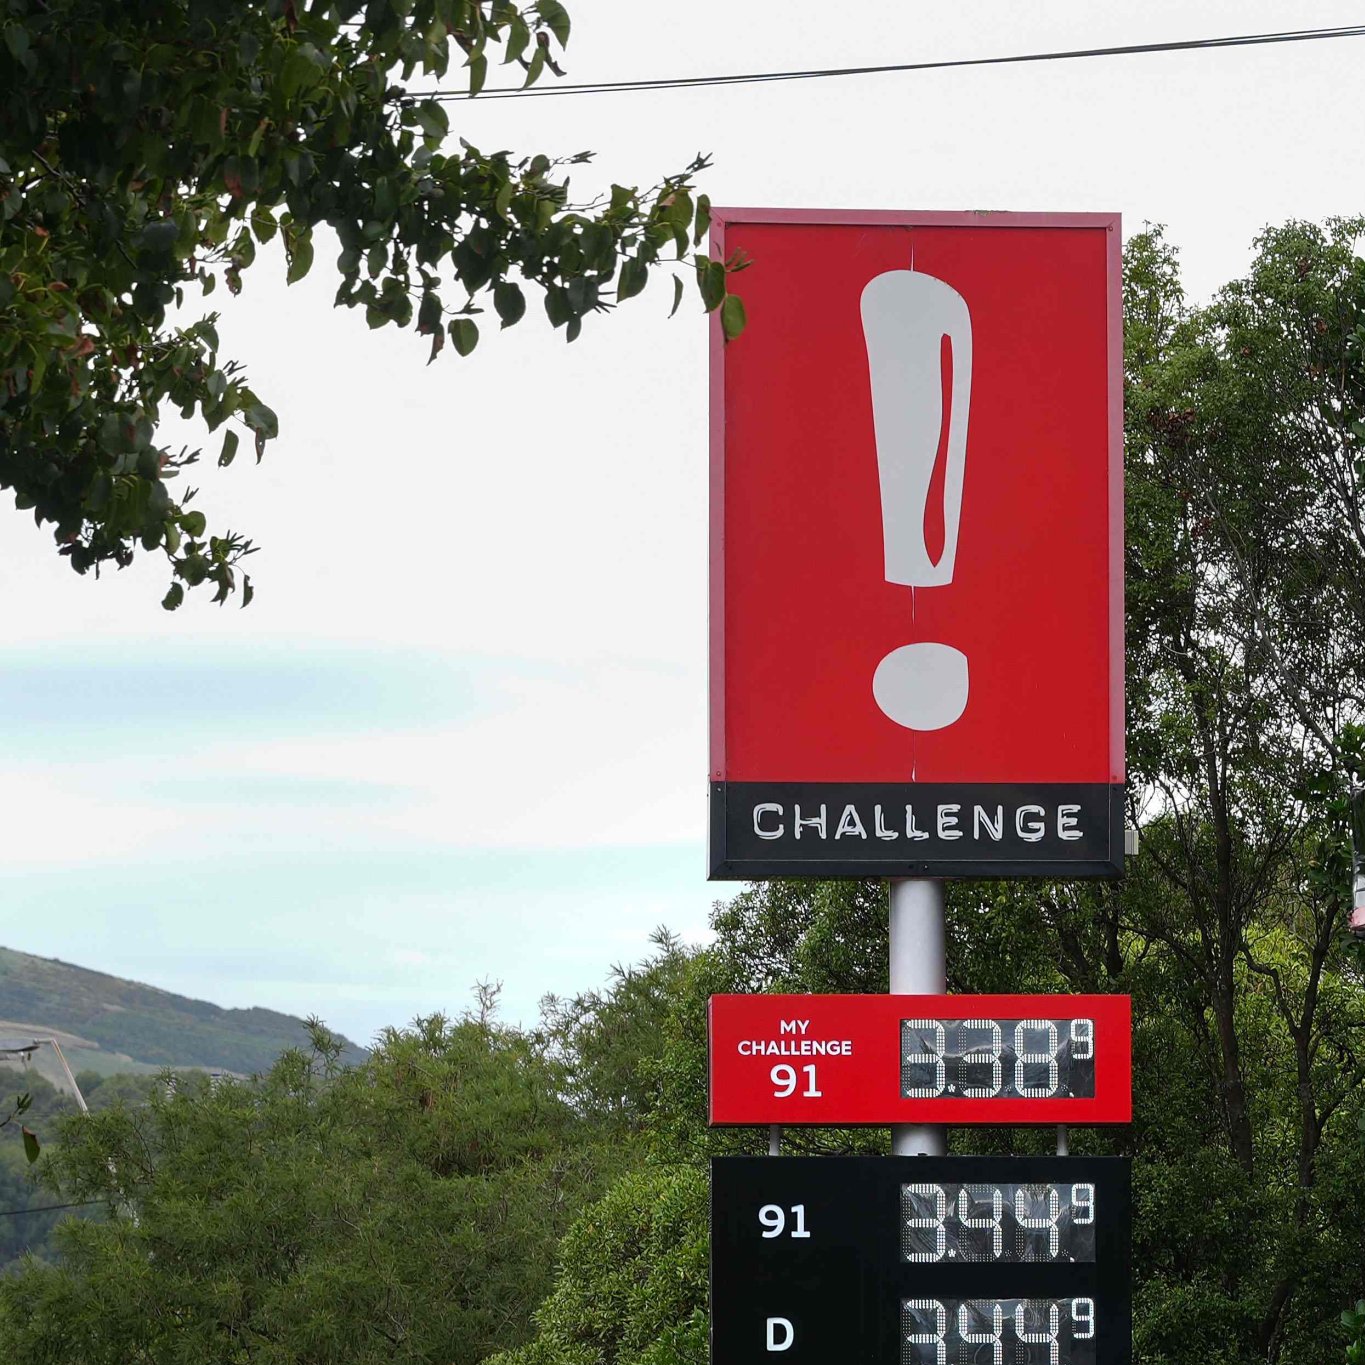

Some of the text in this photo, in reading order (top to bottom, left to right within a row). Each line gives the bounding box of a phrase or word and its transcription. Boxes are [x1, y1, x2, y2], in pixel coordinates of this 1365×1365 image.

[752, 803, 1084, 841] CHALLENGE
[779, 1019, 811, 1036] MY
[737, 1040, 852, 1056] CHALLENGE
[769, 1064, 822, 1098] 91
[757, 1204, 811, 1238] 91
[766, 1317, 794, 1351] D
